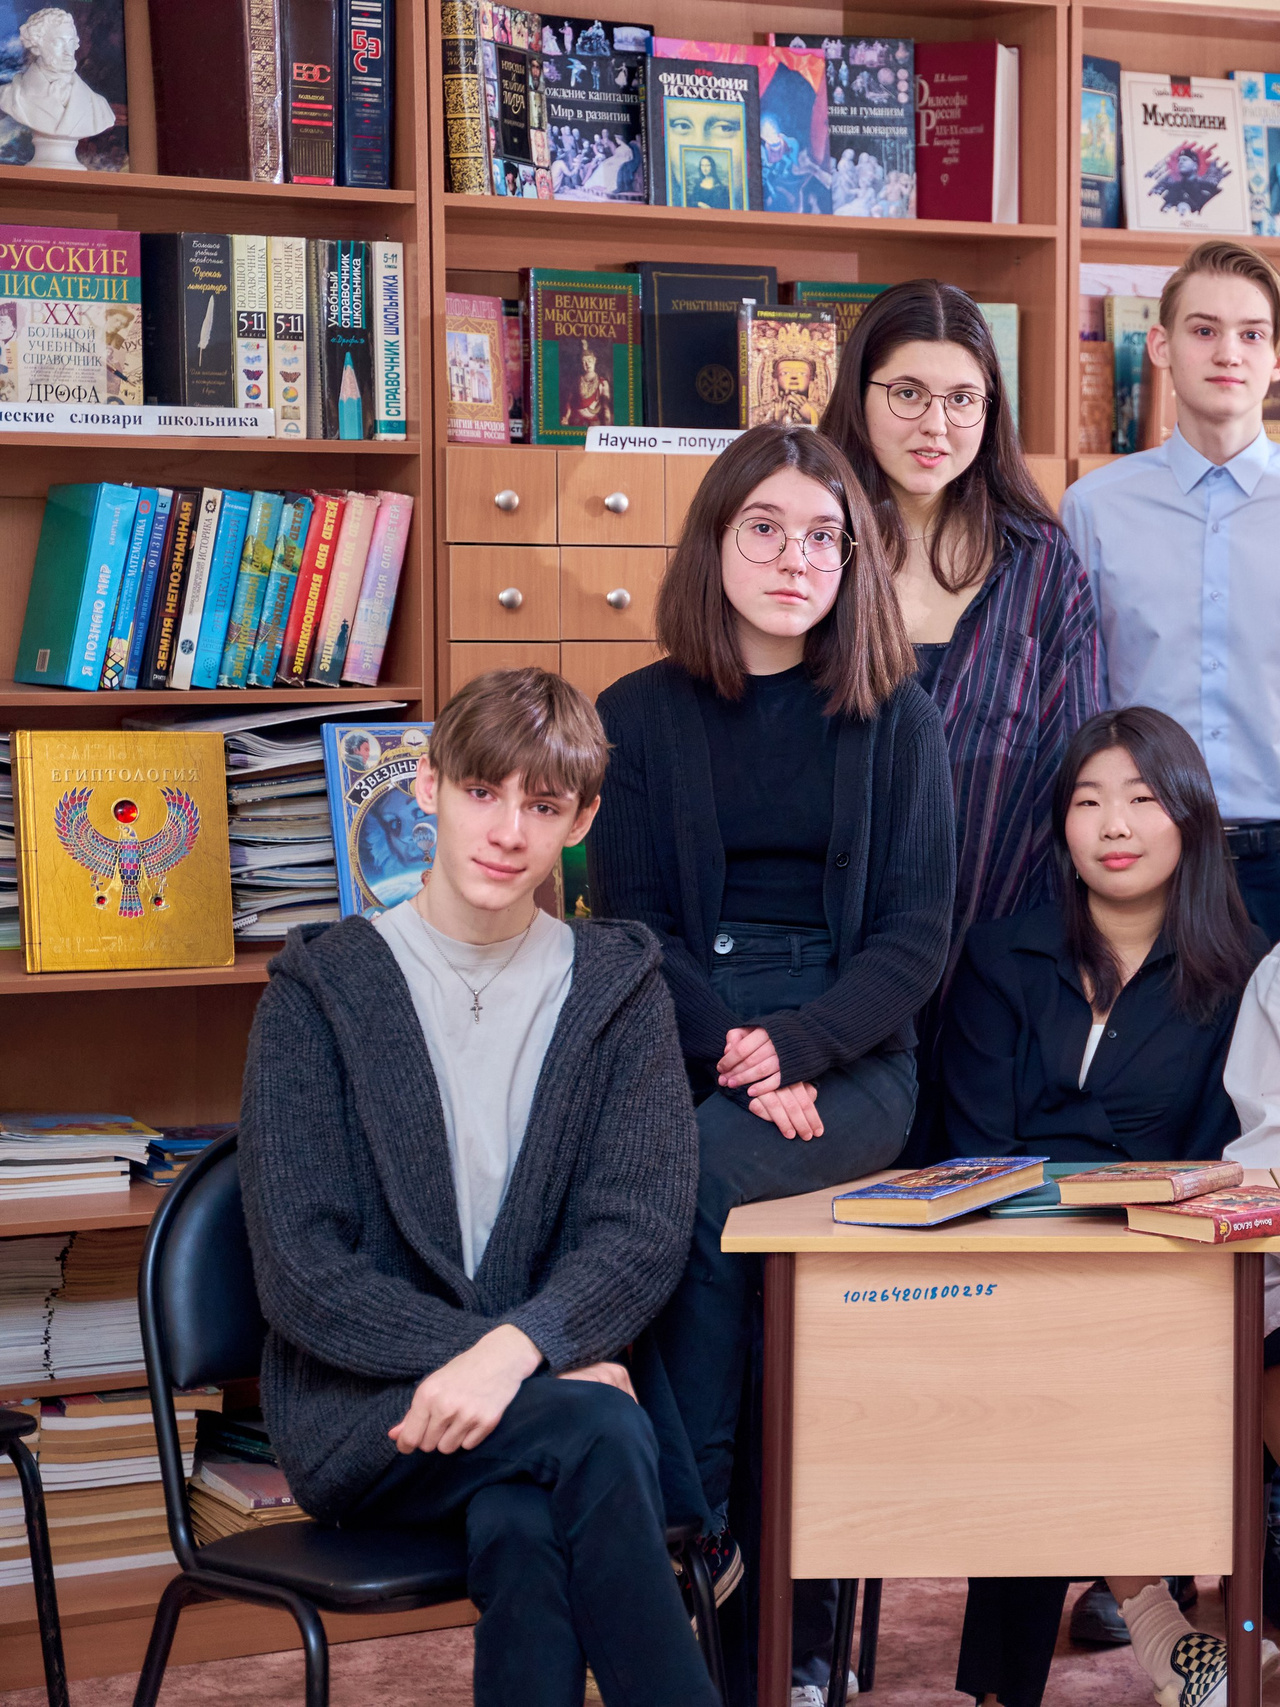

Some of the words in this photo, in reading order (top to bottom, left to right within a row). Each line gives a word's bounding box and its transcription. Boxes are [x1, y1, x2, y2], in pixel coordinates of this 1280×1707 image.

[545, 87, 586, 100] ождение
[588, 90, 639, 103] капитализ
[658, 72, 749, 91] ФИЛОСОФИЯ
[663, 84, 745, 102] ИСКУССТВА
[550, 103, 574, 121] Мир
[576, 109, 583, 118] в
[585, 110, 630, 123] развитии
[850, 107, 858, 115] и
[859, 107, 905, 118] гуманизм
[1142, 103, 1226, 130] Муссолини
[192, 240, 220, 249] Большой
[383, 253, 398, 264] 5-11
[192, 265, 222, 280] Русская
[235, 258, 247, 309] БОЛЬШОЙ
[247, 244, 257, 309] СПРАВОЧНИК
[257, 247, 266, 309] ШКОЛЬНИКА
[272, 258, 283, 310] БОЛЬШОЙ
[284, 243, 294, 310] СПРАВОЧНИК
[294, 247, 304, 310] ШКОЛЬНИКА
[187, 283, 228, 295] литература
[327, 271, 340, 328] Учебный
[340, 253, 350, 329] справочник
[352, 258, 362, 329] школьника
[383, 274, 399, 336] ШКОЛЬНИКА
[544, 308, 627, 325] МЫСЛИТЕЛИ
[555, 295, 617, 311] ВЕЛИКИЕ
[671, 299, 739, 312] ХРИСТИАНСТ
[27, 326, 95, 340] БОЛЬШОЙ
[238, 312, 266, 332] 5-11
[276, 314, 303, 335] 5-11
[555, 323, 617, 338] ВОСТОКА
[28, 339, 96, 353] УЧЕБНЫЙ
[740, 331, 748, 376] БУДДИЗМ
[23, 353, 103, 367] СПРАВОЧНИК
[384, 339, 401, 417] СПРАВОЧНИК
[27, 383, 101, 404] ДРОФА
[70, 412, 142, 429] словари
[158, 413, 259, 428] школьника
[598, 432, 658, 450] Научно
[678, 436, 733, 451] популя
[322, 501, 339, 540] ДЕТЕЙ
[386, 503, 401, 542] ДЕТЕЙ
[127, 518, 146, 578] МАТЕМАТИКА
[147, 515, 166, 568] ФИЗИКА
[197, 518, 213, 564] ИСТОРИКА
[315, 543, 330, 570] ДЛЯ
[381, 544, 393, 569] ДЛЯ
[96, 563, 112, 596] МИР
[156, 617, 174, 671] ЗЕМЛЯ
[165, 501, 193, 614] НЕПОЗНАННАЯ
[211, 518, 241, 634] ЭНЦИКЛОПЕДИЯ
[319, 572, 350, 673] ЭНЦИКЛОПЕДИЯ
[342, 542, 356, 567] ДЛЯ
[349, 498, 364, 538] ДЕТЕЙ
[261, 575, 290, 678] ЭНЦИКЛОПЕДИЯ
[288, 502, 306, 542] ДЕТЕЙ
[84, 599, 106, 662] ПОЗНАЮ
[232, 576, 260, 679] ЭНЦИКЛОПЕДИЯ
[293, 573, 323, 674] ЭНЦИКЛОПЕДИЯ
[362, 573, 388, 671] ЭНЦИКЛОПЕДИЯ
[81, 665, 93, 677] Я
[51, 768, 200, 783] ЕГИПТОЛОГИЯ
[354, 760, 419, 799] ЗВЕЗДНЫ
[1232, 1220, 1253, 1232] БЕЛОВ
[1254, 1218, 1273, 1228] Вольф
[843, 1283, 998, 1303] 101264201800295
